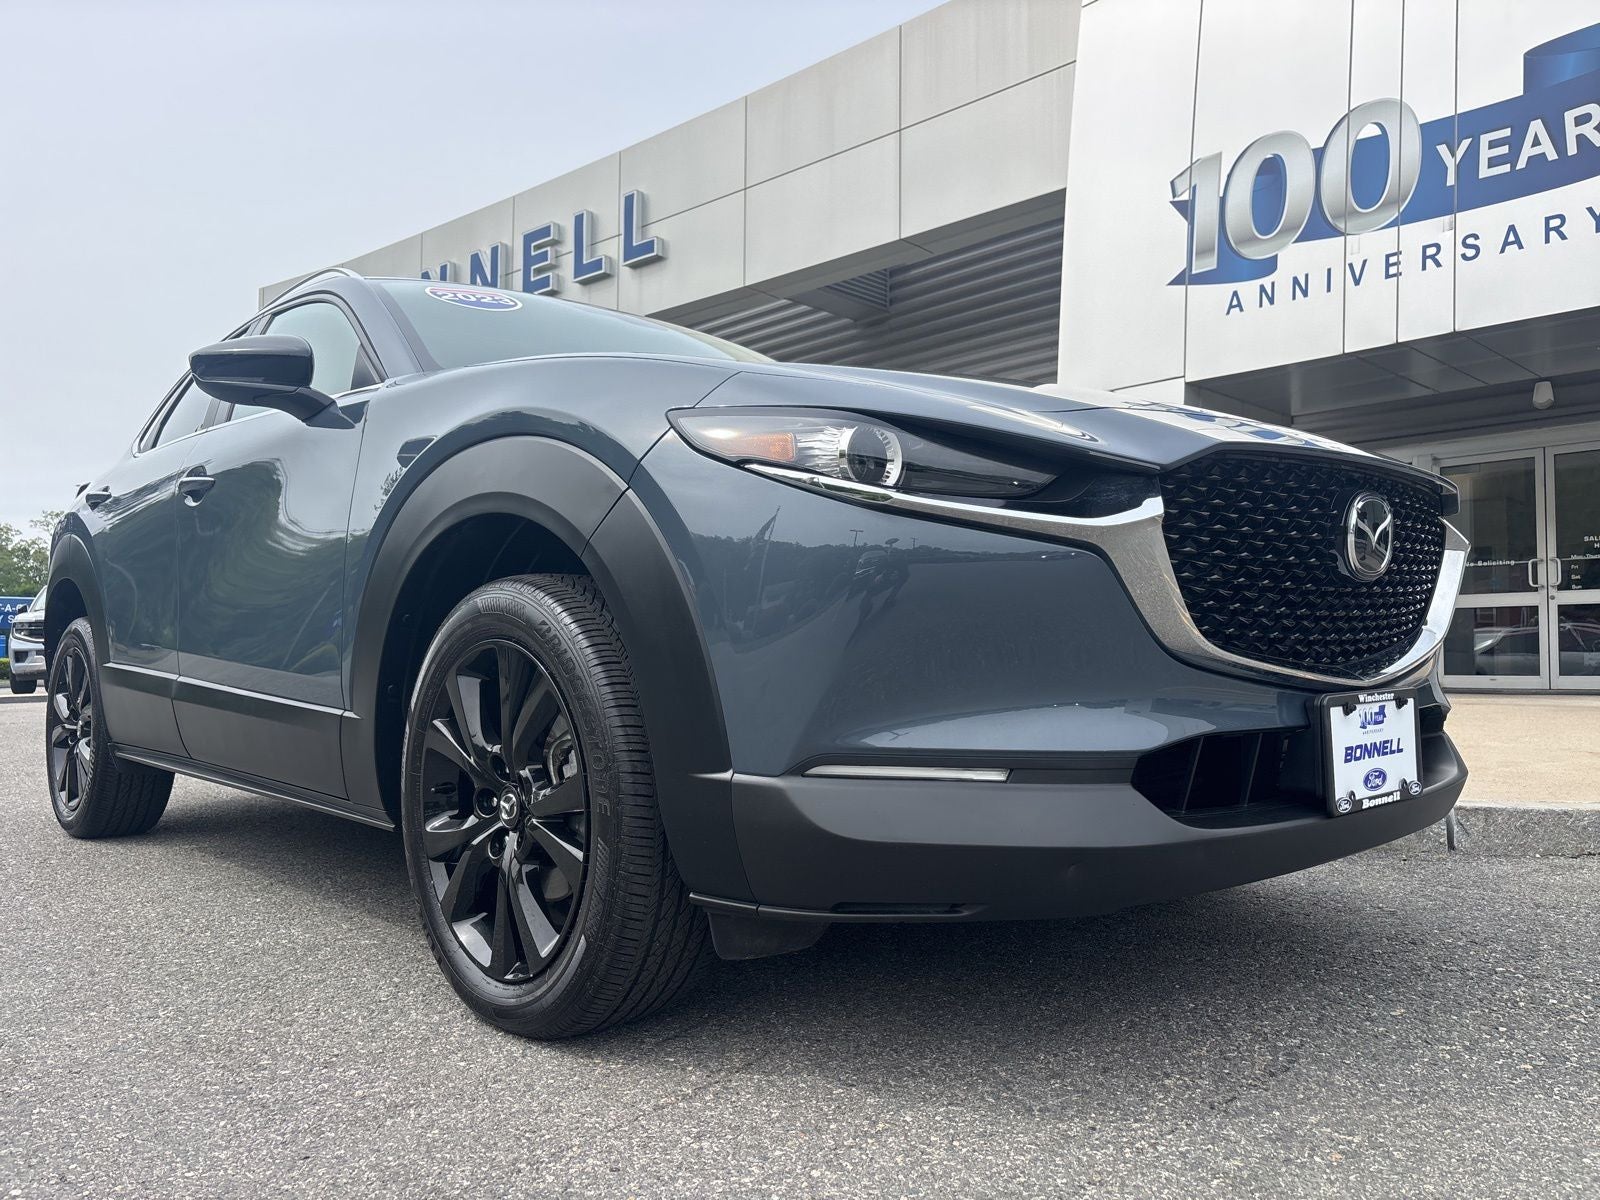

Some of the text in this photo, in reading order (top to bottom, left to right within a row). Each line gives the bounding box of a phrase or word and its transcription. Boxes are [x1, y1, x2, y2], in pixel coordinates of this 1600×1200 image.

[1170, 98, 1600, 274] 100 YEAR
[434, 291, 516, 305] 2023
[1358, 693, 1394, 703] Winchester
[1344, 738, 1404, 764] BONNELL
[1362, 791, 1400, 809] Bonnell
